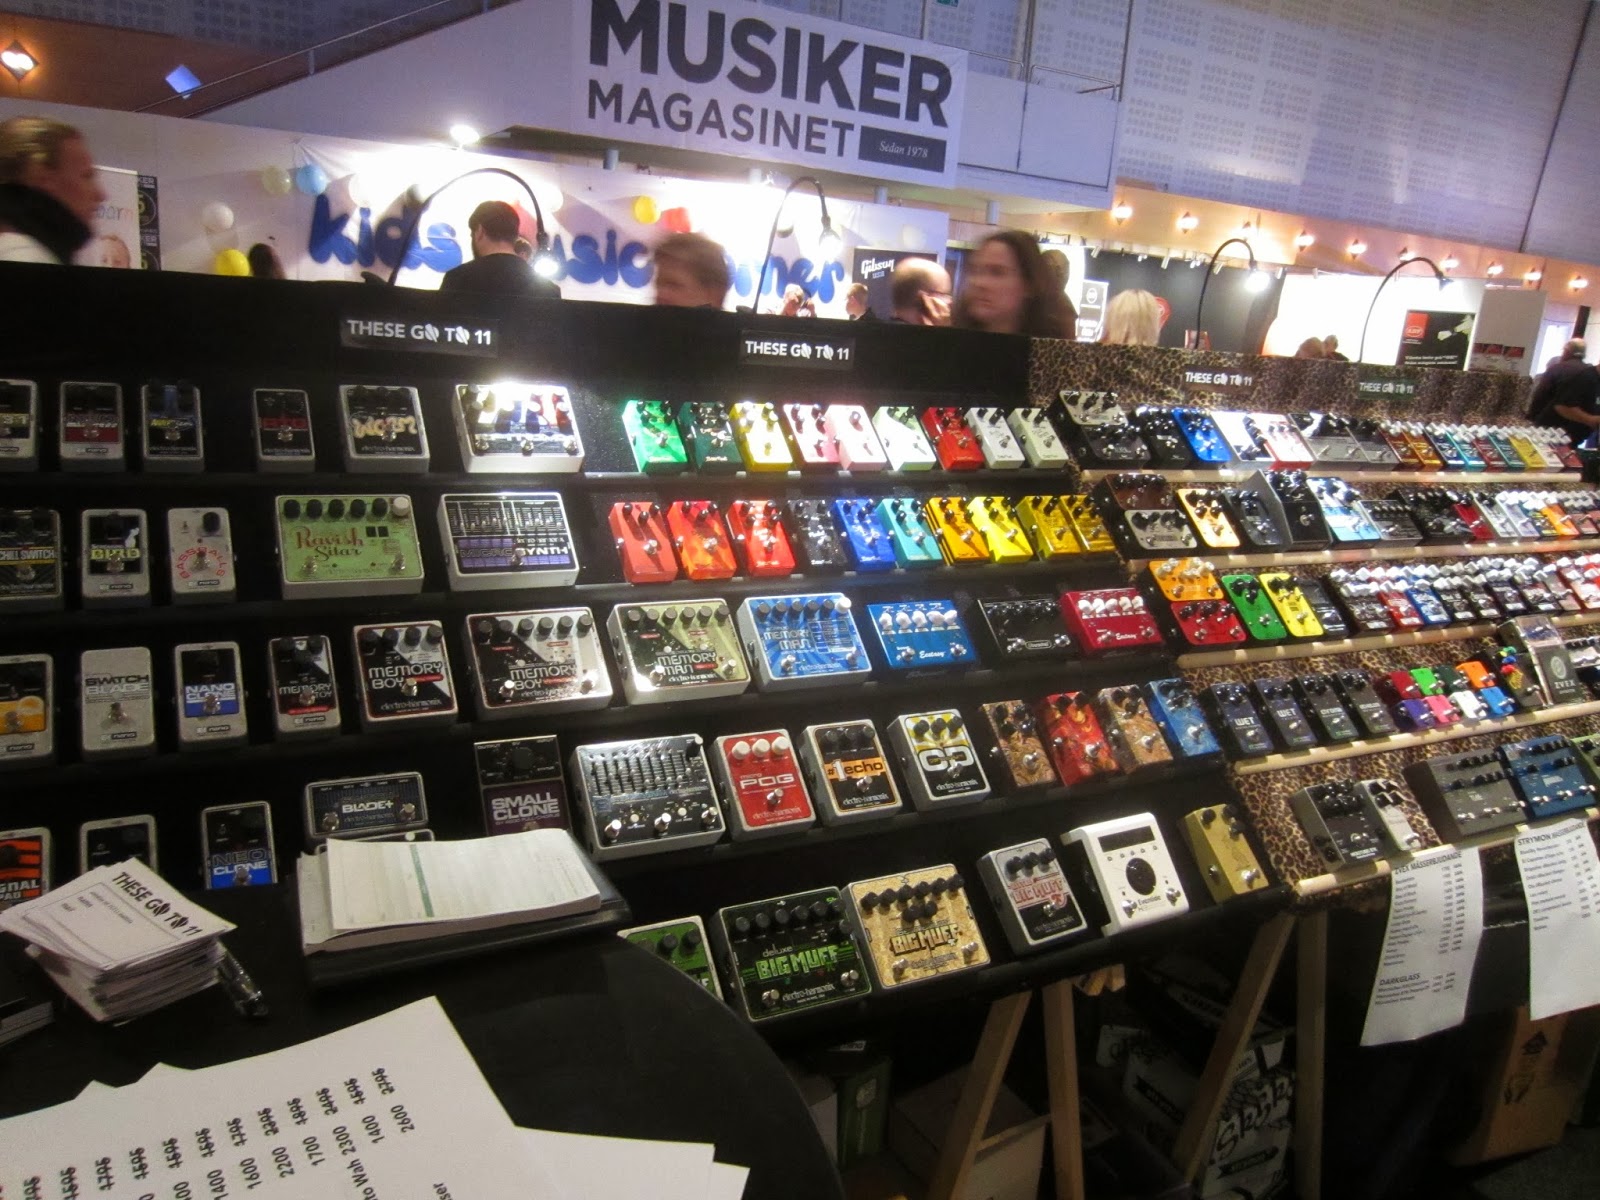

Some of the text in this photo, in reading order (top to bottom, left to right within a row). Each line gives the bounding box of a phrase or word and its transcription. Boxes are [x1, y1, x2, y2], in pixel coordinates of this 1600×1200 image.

[589, 0, 952, 128] MUSIKER
[587, 79, 855, 157] MAGASINET
[879, 140, 929, 158] Sedan 1978
[308, 194, 463, 273] kids
[861, 257, 895, 279] Gibson
[347, 319, 492, 346] THESE GO TO 11
[745, 340, 850, 361] THESE GO TO 11
[1185, 371, 1252, 387] THESE GO TO 11
[1359, 381, 1414, 394] THESE GO TO 11
[291, 526, 364, 549] Ravish
[315, 545, 363, 561] Sitar
[779, 638, 812, 651] MAN
[657, 651, 717, 666] MEMORY
[368, 661, 444, 679] MEMORY
[510, 663, 577, 681] MEMORY
[663, 664, 694, 676] MAN
[85, 674, 149, 686] SWITCH
[85, 683, 150, 695] BLADE
[184, 683, 236, 693] NANO
[279, 682, 332, 695] MEMORY
[371, 677, 405, 690] BOY
[513, 678, 541, 690] BOY
[1554, 679, 1577, 689] ZVEX
[186, 690, 236, 701] CLONE
[1234, 716, 1255, 727] WET
[1276, 707, 1297, 718] WET
[739, 773, 795, 790] POG
[341, 799, 394, 814] BLADE+
[491, 791, 559, 810] SMALL
[493, 803, 560, 821] CLONE
[1517, 834, 1551, 846] STRYMON
[212, 848, 267, 866] NEO
[112, 871, 153, 902] THESE
[145, 898, 171, 917] GO
[164, 912, 189, 929] TO
[182, 925, 203, 936] 11
[890, 932, 921, 956] BIG
[918, 923, 959, 949] MUFF
[762, 943, 794, 957] deluxe
[755, 944, 839, 980] BIG MUFF
[391, 1105, 415, 1133] 2600
[362, 1115, 385, 1144] 1400
[332, 1125, 357, 1156] 2300
[302, 1136, 325, 1166] 1700
[272, 1146, 295, 1178] 2200
[240, 1157, 262, 1190] 1600
[346, 1158, 369, 1188] Wah
[207, 1169, 229, 1200] 1400
